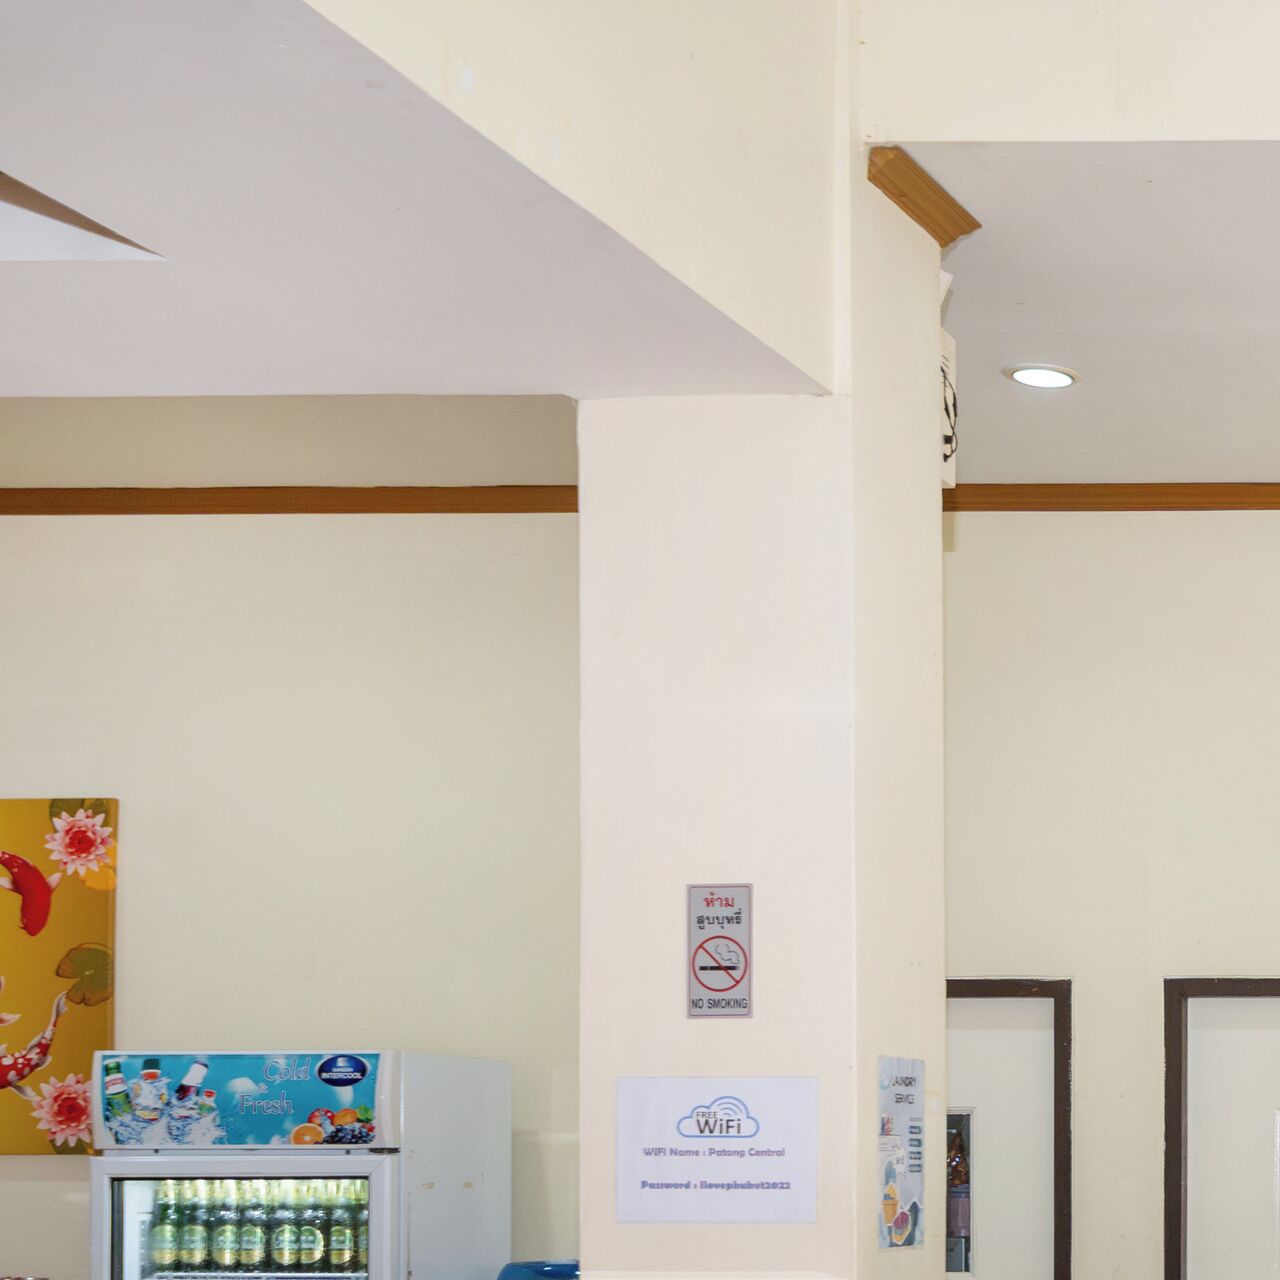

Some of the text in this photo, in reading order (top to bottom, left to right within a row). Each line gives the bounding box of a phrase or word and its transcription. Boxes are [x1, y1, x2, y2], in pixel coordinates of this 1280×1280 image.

[704, 891, 735, 908] ห้าม
[691, 998, 748, 1009] NO SMOKING
[263, 1057, 312, 1082] Cold
[239, 1091, 294, 1115] Fresh
[695, 1111, 719, 1119] FREE
[696, 1118, 742, 1134] WiFi
[670, 1148, 700, 1157] Name
[708, 1148, 746, 1159] Patong
[748, 1148, 786, 1157] Central
[640, 1180, 691, 1190] Password
